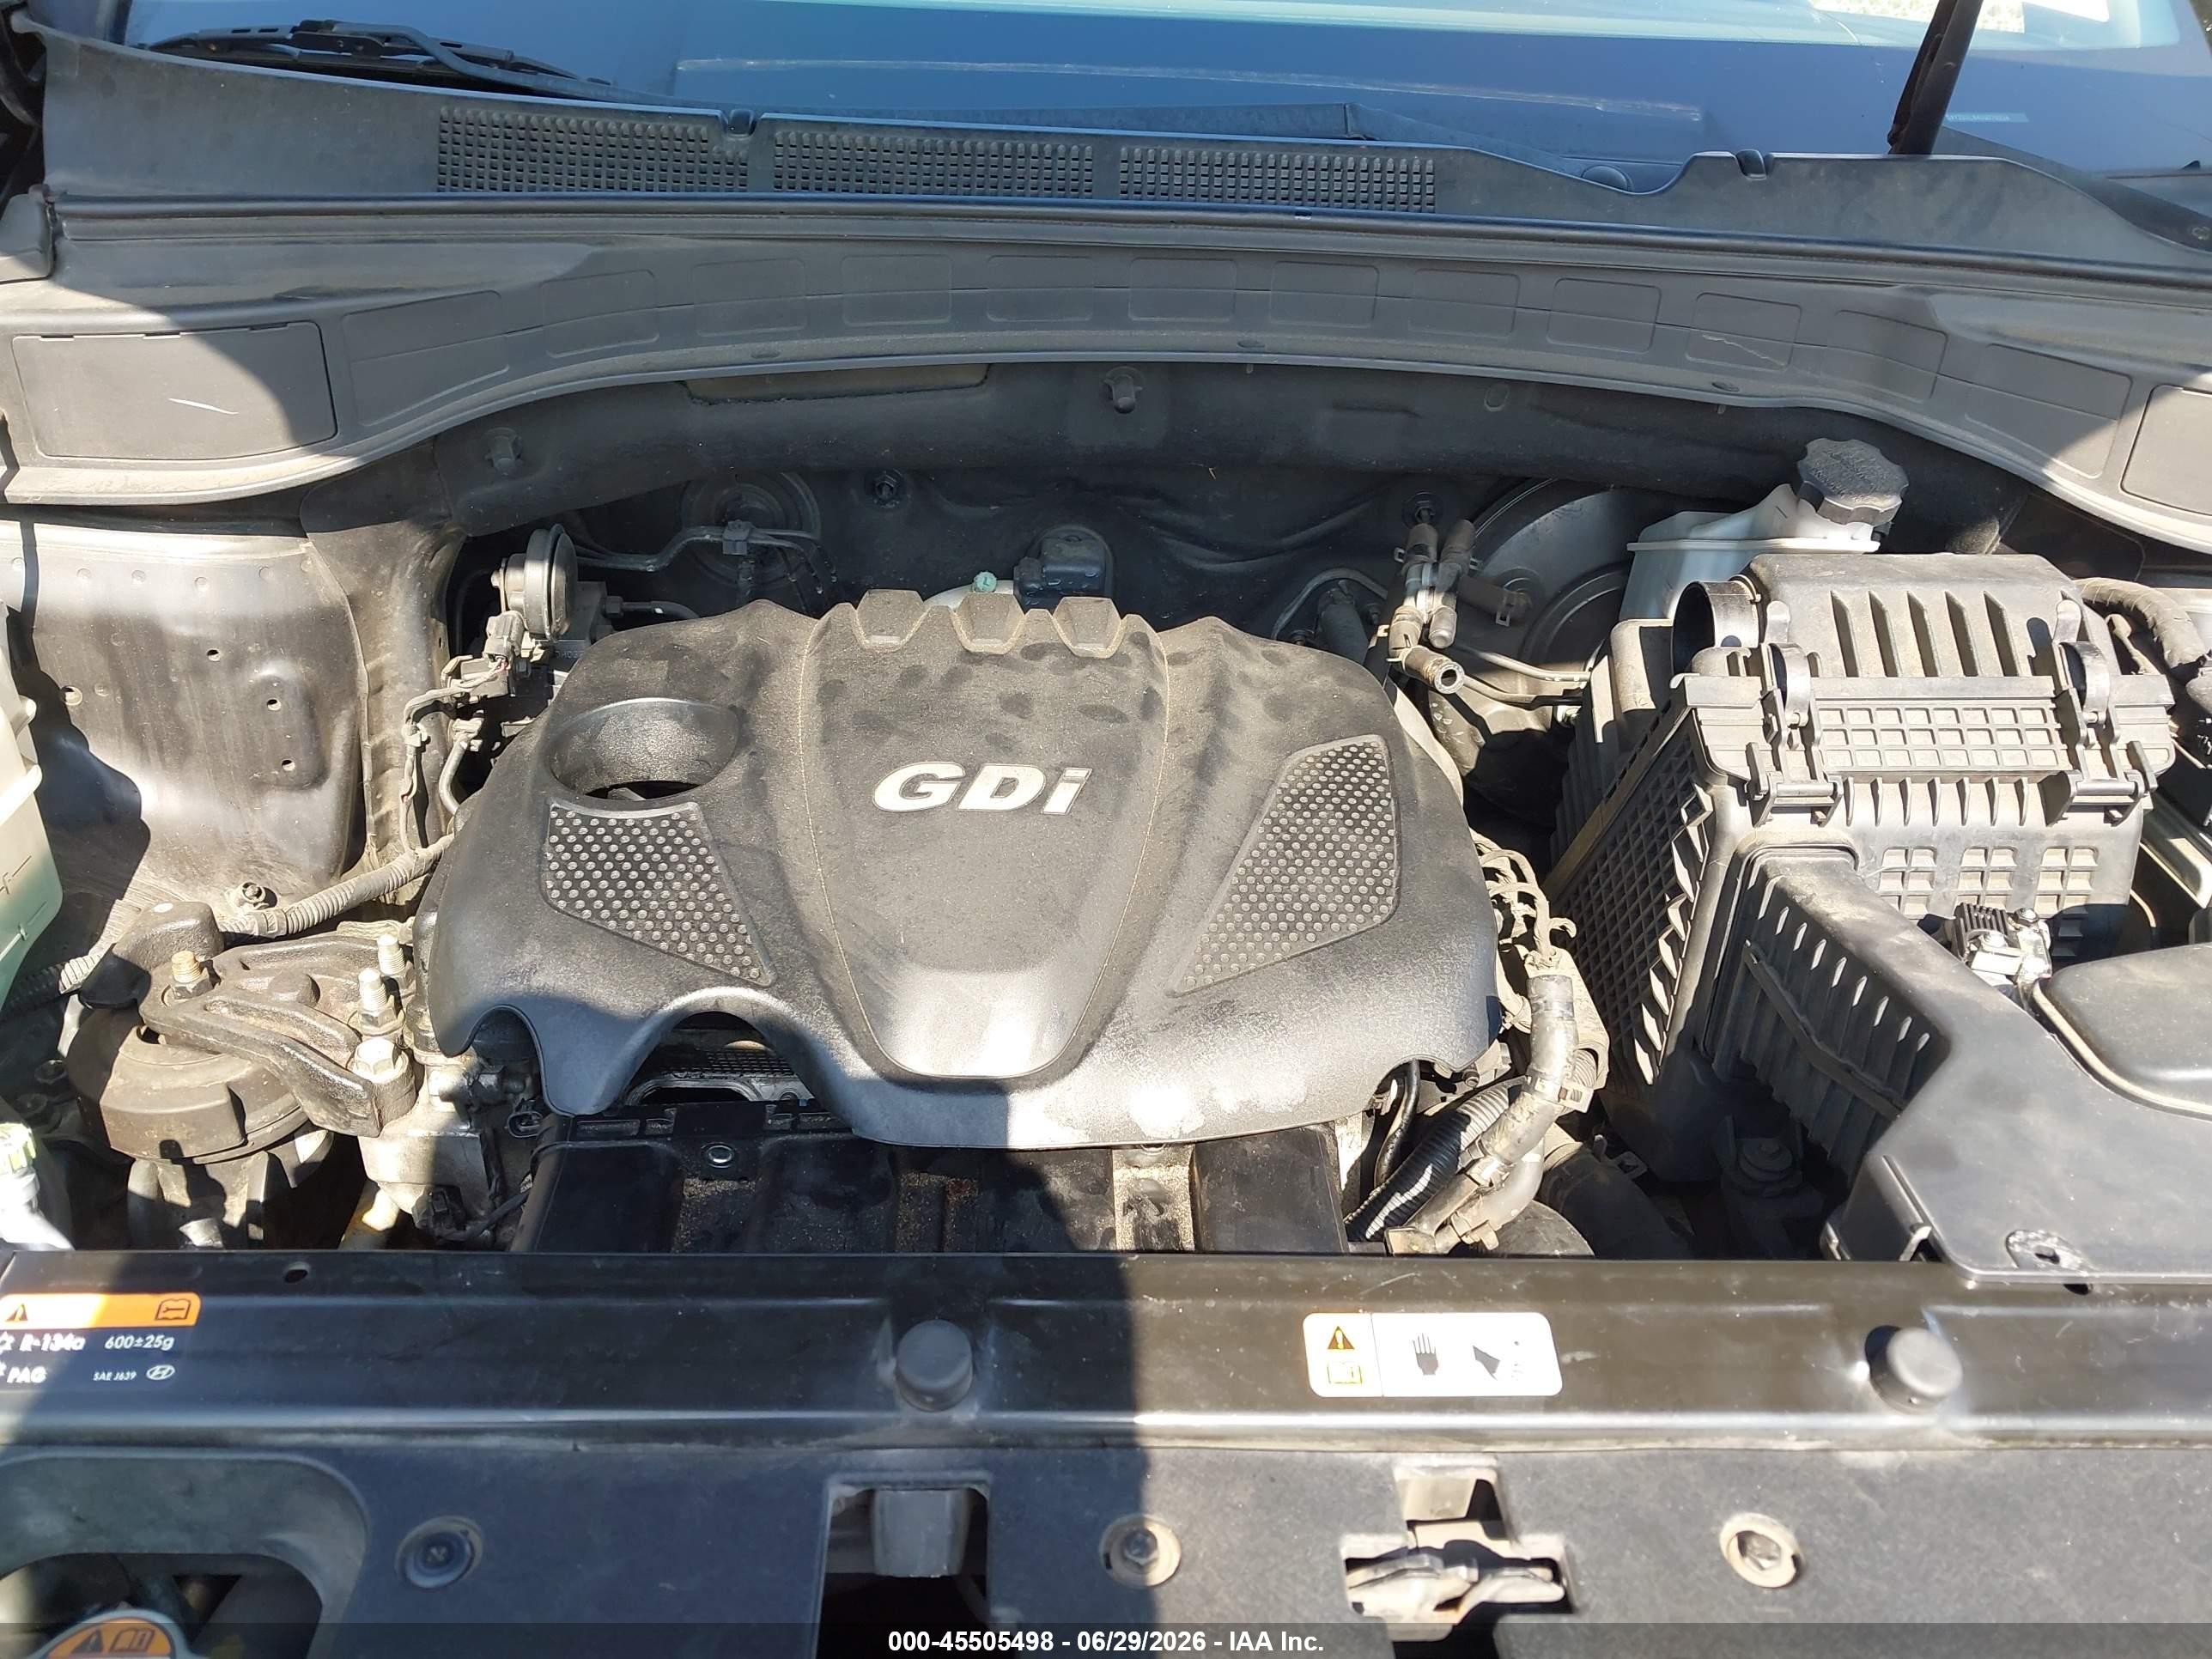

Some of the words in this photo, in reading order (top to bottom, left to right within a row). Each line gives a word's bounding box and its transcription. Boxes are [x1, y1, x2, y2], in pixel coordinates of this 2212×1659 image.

[872, 761, 1093, 816] GDi
[104, 1334, 175, 1352] 600±25g
[6, 1365, 47, 1383] PAG
[93, 1371, 112, 1382] SAE
[112, 1370, 137, 1381] J639
